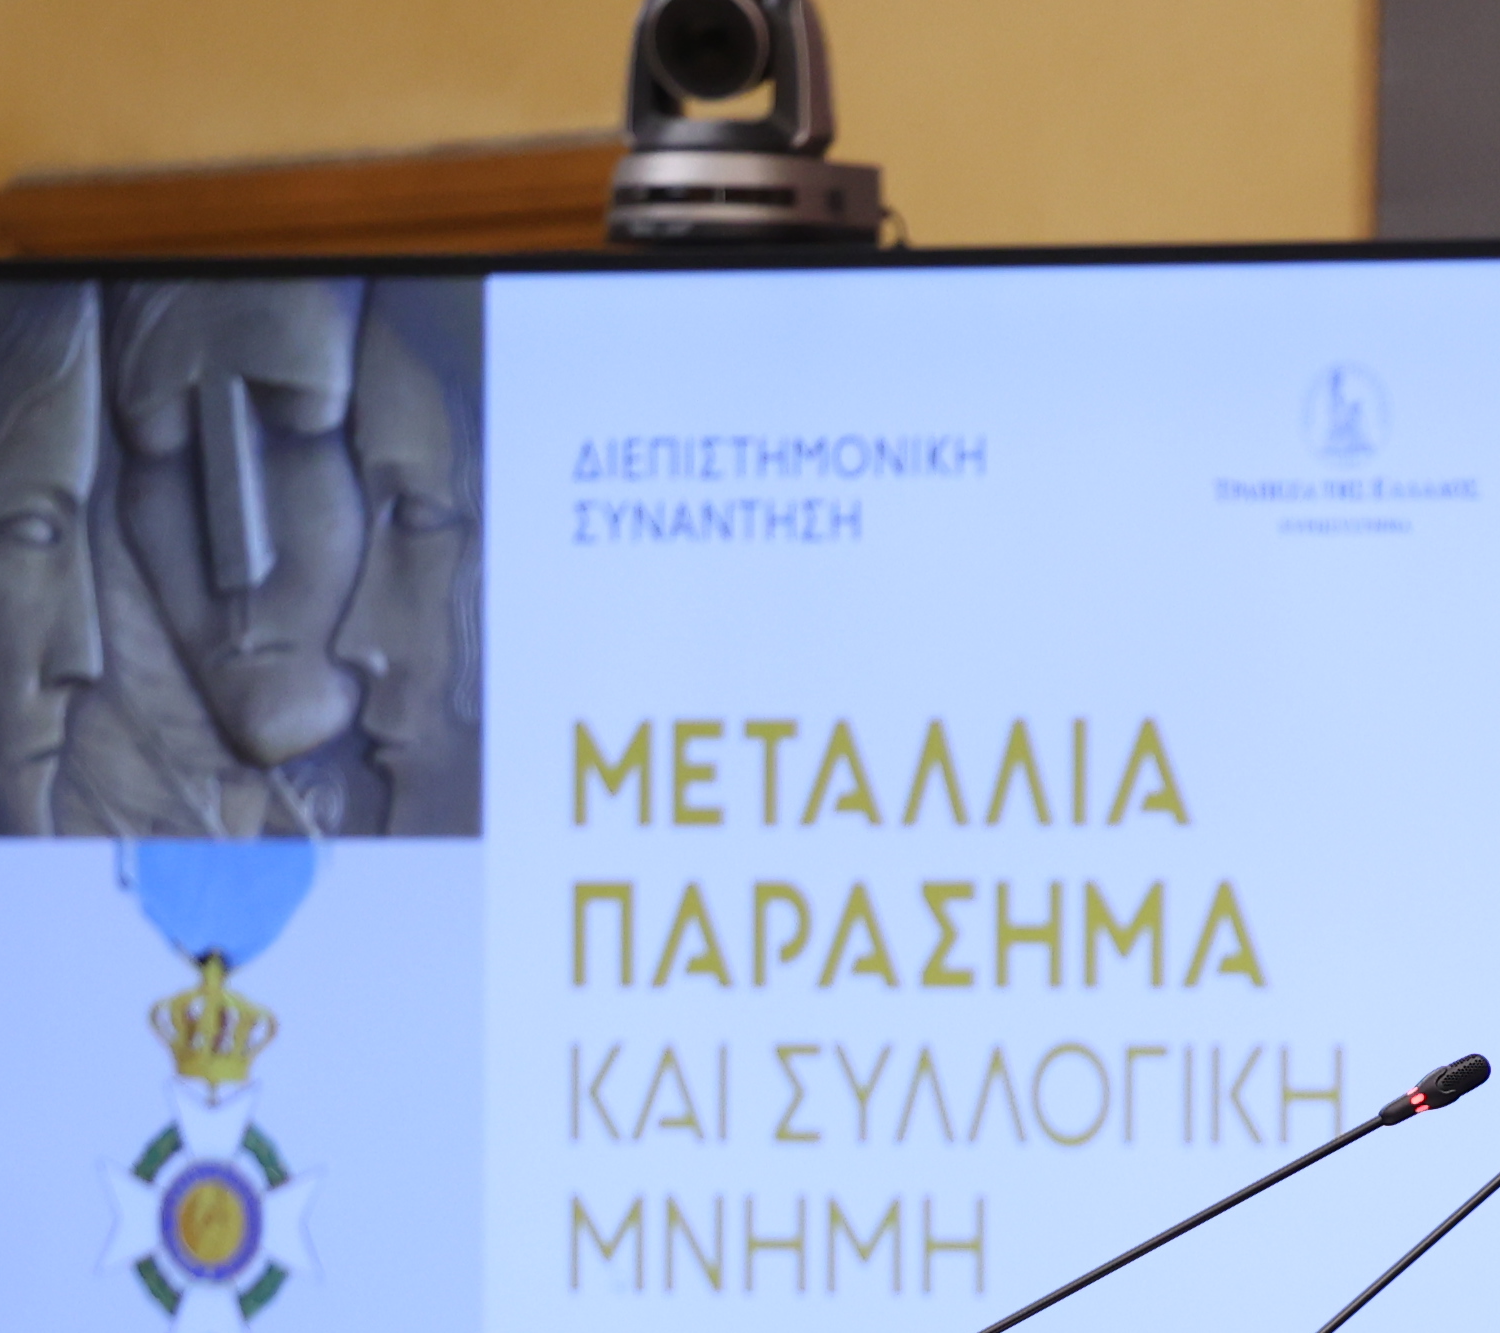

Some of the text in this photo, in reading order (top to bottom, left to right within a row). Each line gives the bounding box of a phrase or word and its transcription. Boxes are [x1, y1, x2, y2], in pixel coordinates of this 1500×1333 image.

[572, 434, 988, 482] ΔΙΕΠΙΣΤΗΜΟΝΙΚΗ
[572, 499, 864, 544] ΣΥΝΑΝΤΗΣΗ
[572, 718, 1192, 828] ΜΕΤΑΛΛΙΑ
[572, 880, 1268, 990] ΠΑΡΑΣΗΜΑ
[570, 1043, 1344, 1147] ΚΑΙ ΣΥΛΛΟΓΙΚΗ
[570, 1196, 986, 1294] ΜΝΗΜΗ
